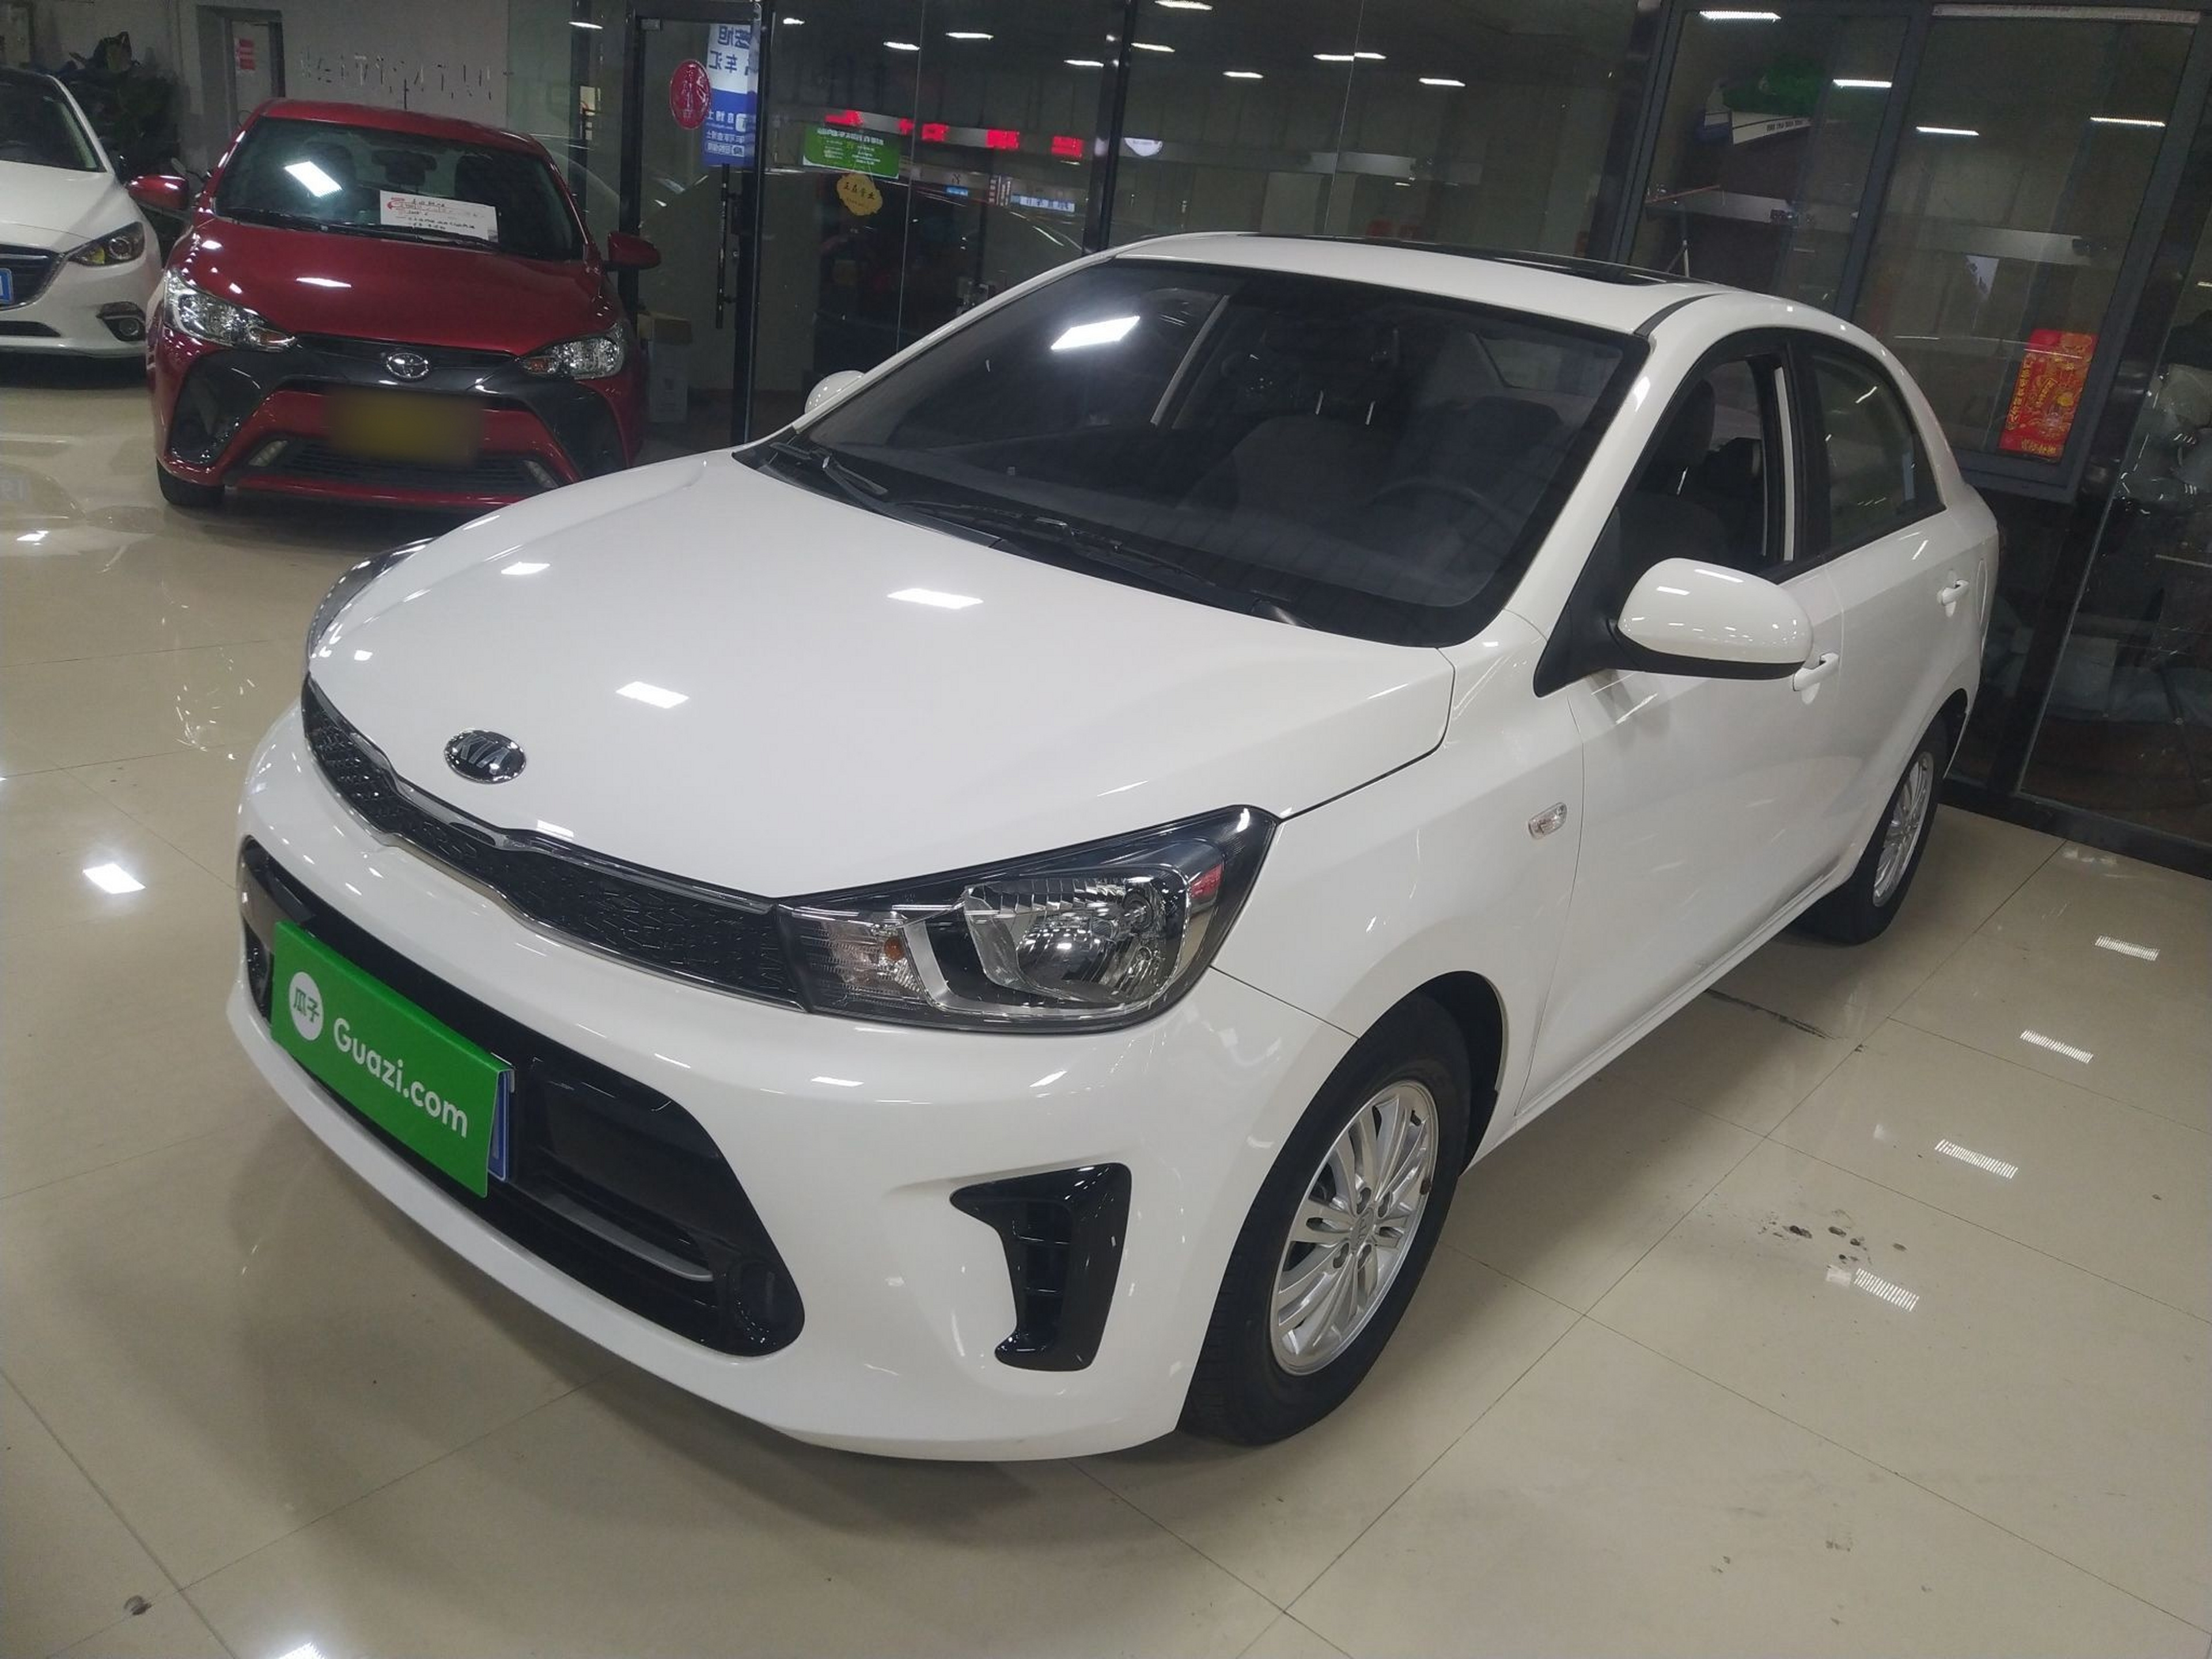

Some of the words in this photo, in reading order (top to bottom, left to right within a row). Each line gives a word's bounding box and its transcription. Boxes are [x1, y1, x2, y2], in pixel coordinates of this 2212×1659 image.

[452, 732, 510, 775] KIA
[293, 987, 321, 1025] 瓜子
[334, 1018, 468, 1138] Guazi.com
